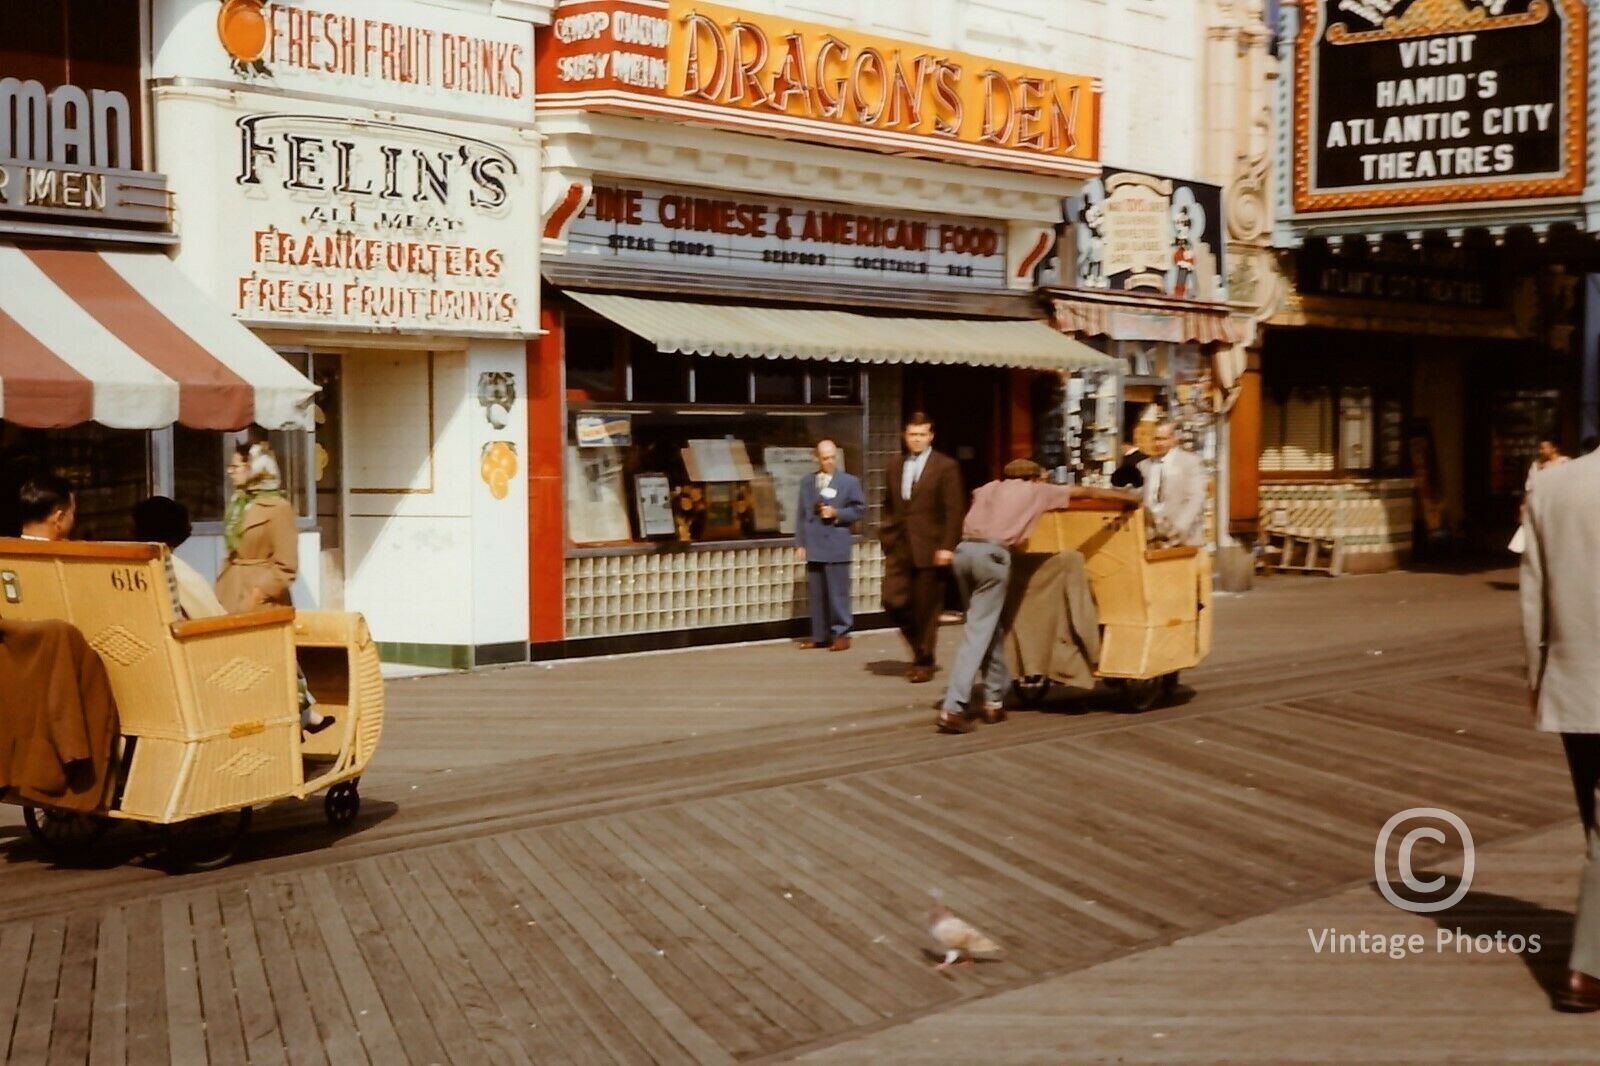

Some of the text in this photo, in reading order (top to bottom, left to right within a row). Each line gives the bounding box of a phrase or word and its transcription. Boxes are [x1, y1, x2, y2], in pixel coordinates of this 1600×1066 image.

[270, 4, 523, 99] FRESH FRUIT DRINKS
[1399, 34, 1477, 69] VISIT
[683, 11, 1080, 152] DRAGON'S DEN
[1376, 70, 1498, 108] HAMID'S
[1326, 103, 1554, 148] ATLANTIC CITY
[236, 114, 518, 209] FELIN'S
[1360, 144, 1514, 181] THEATRES
[27, 168, 106, 209] MEN
[658, 194, 768, 238] CHINESE
[802, 210, 927, 252] AMERICAN
[939, 224, 998, 257] FOOD
[254, 230, 503, 278] FRANKFURTERS
[239, 276, 515, 322] FRESH FRUIT DRINKS
[111, 568, 148, 592] 616
